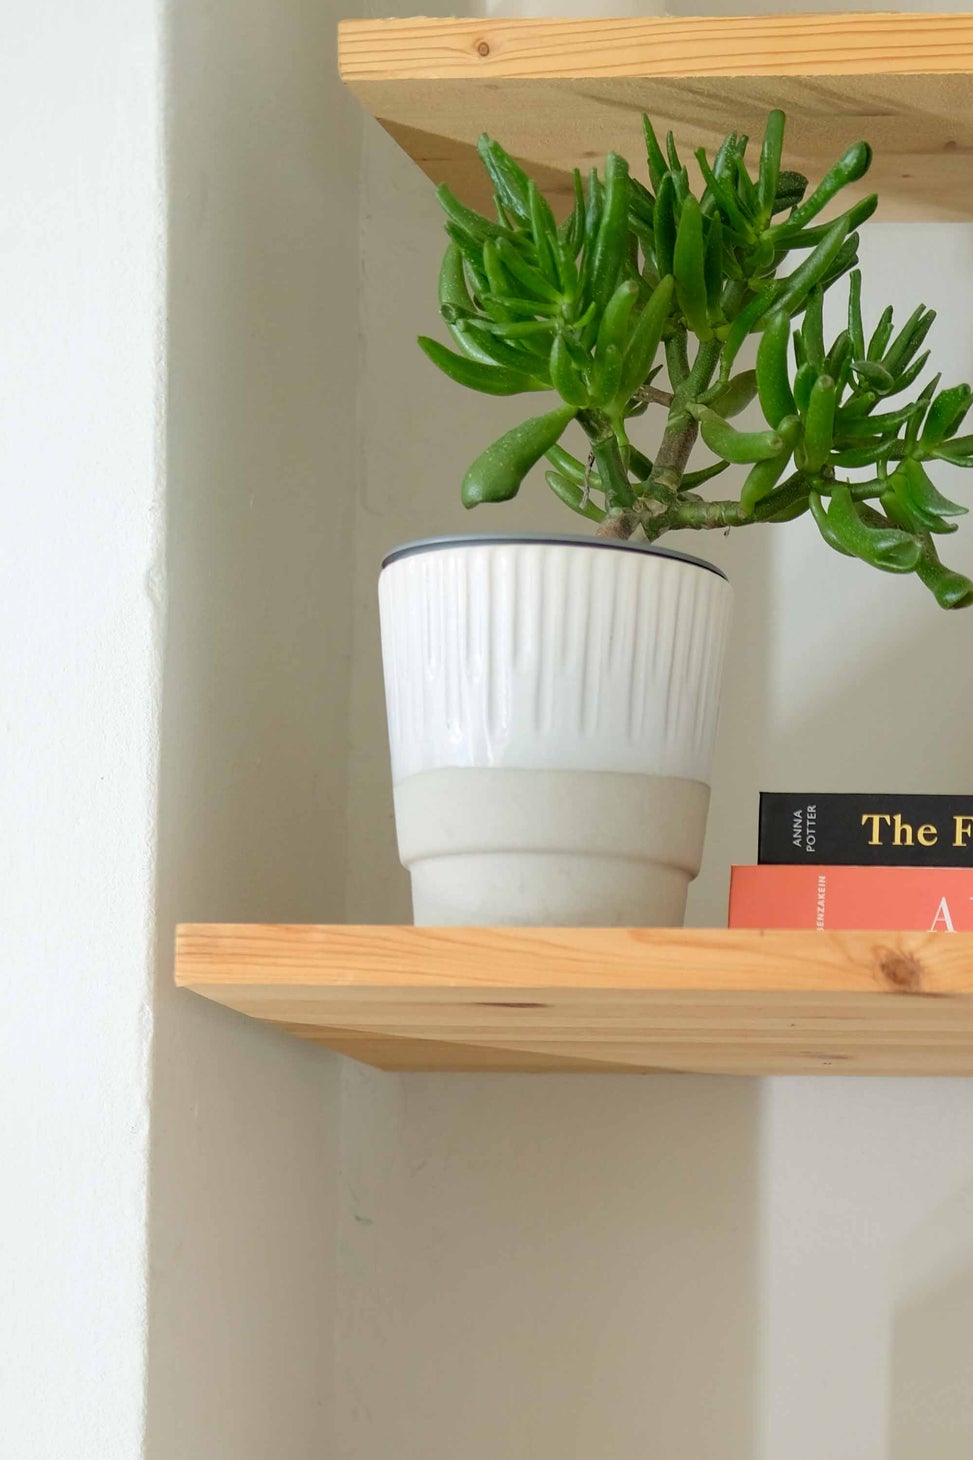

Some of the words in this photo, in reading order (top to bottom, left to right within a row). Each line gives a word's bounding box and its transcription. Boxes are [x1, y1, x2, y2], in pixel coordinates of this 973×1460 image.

[793, 809, 803, 848] ANNA
[806, 804, 817, 853] POTTER
[861, 812, 938, 847] The
[927, 896, 958, 933] A
